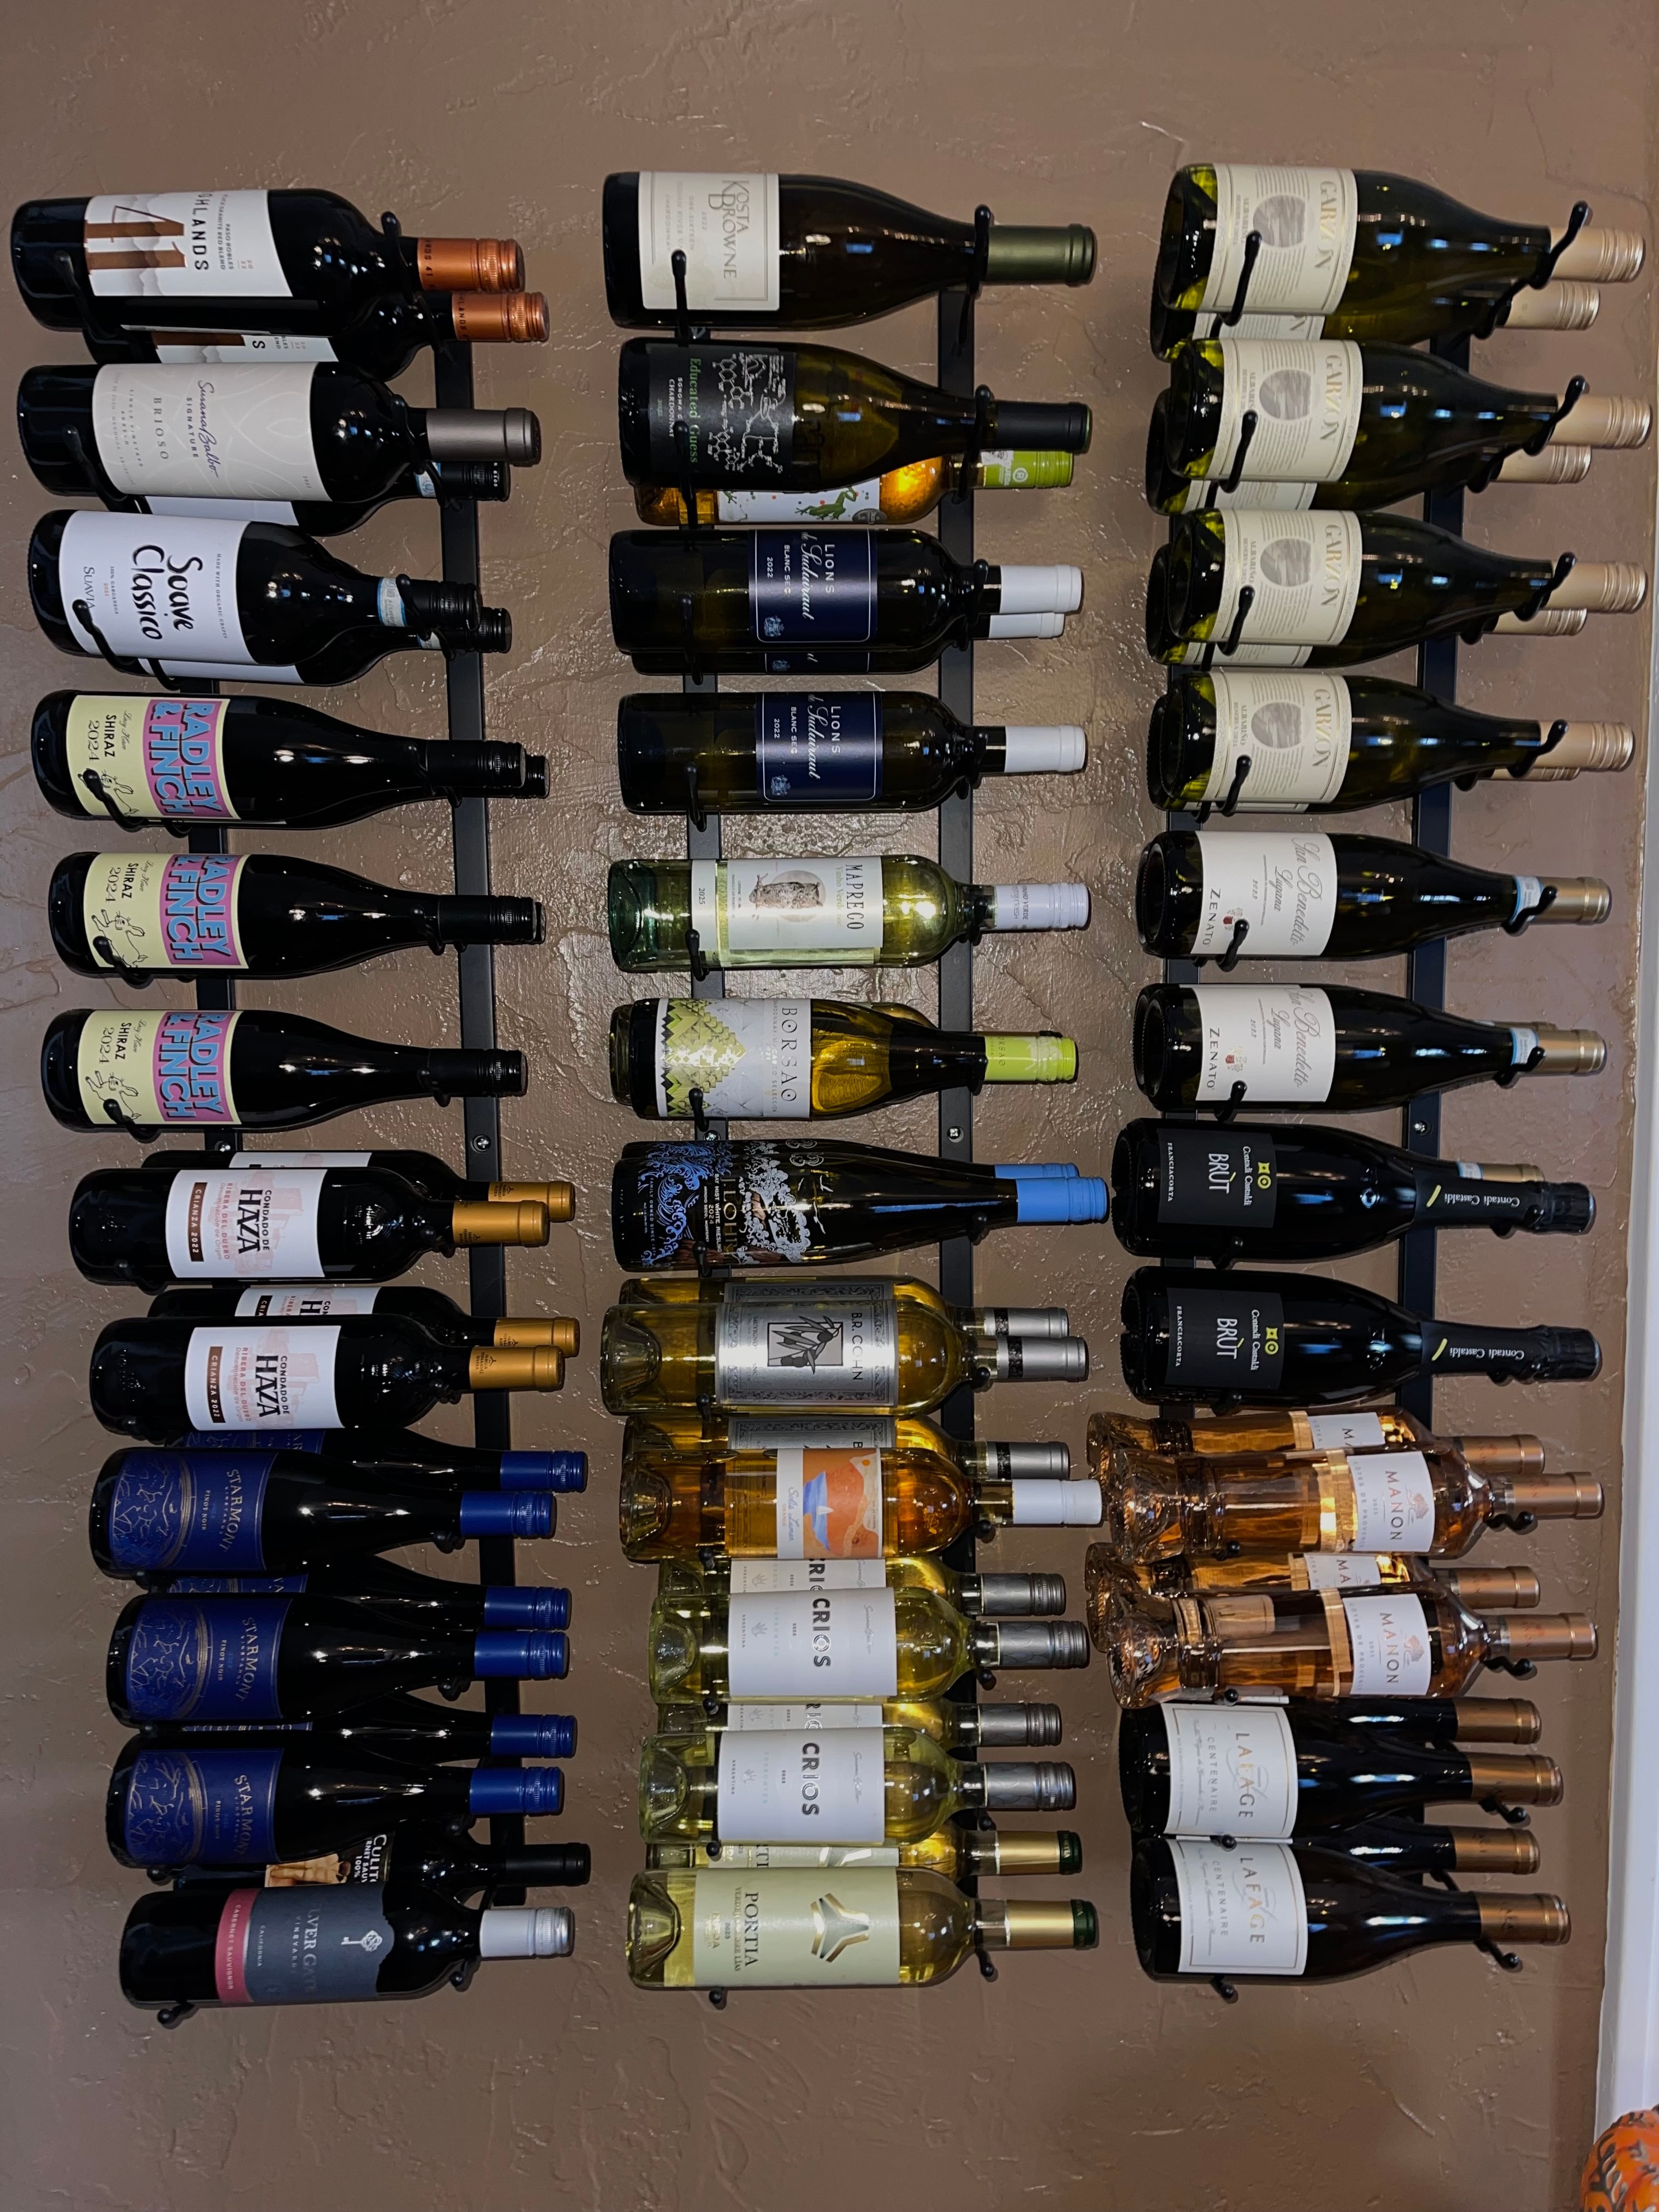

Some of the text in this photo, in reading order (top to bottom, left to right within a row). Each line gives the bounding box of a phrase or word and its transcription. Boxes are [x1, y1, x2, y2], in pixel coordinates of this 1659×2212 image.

[708, 194, 737, 280] BROWNE
[722, 180, 749, 233] KOSTA
[226, 242, 234, 270] ROBLES
[120, 410, 130, 446] AGRELO
[153, 397, 169, 461] BRIOSO
[186, 397, 199, 459] SIGNATURE
[689, 358, 701, 463] Educated Guess
[130, 425, 143, 469] VINEYARD
[84, 566, 96, 610] SUAVIA
[111, 581, 119, 615] GARGANEGA
[131, 544, 166, 641] Classico
[166, 554, 203, 632] Soave
[783, 574, 791, 594] SEC
[801, 531, 823, 621] de Suduiraut
[824, 544, 835, 594] LIONS
[218, 618, 228, 640] GRAPES
[87, 719, 100, 762] 2024
[104, 714, 118, 757] SHIRAZ
[181, 702, 223, 812] RADLEY
[808, 694, 828, 780] de Suduiraut
[831, 706, 841, 753] LIONS
[149, 724, 195, 814] FINCH
[105, 866, 122, 904] 2024
[121, 862, 139, 899] SHIRAZ
[196, 855, 233, 959] RADLEY
[698, 887, 706, 906] 2025
[835, 866, 844, 888] Vinho
[1269, 866, 1293, 912] Lugana
[1290, 865, 1323, 946] Benedetto
[166, 869, 203, 960] FINCH
[1202, 888, 1221, 946] ZENATO
[99, 1026, 115, 1065] 2024
[115, 1022, 132, 1060] SHIRAZ
[781, 1007, 798, 1103] BORSAO
[1206, 1027, 1220, 1088] ZENATO
[1266, 1007, 1290, 1049] Lugana
[1293, 1006, 1321, 1088] Benedetto
[158, 1029, 196, 1119] FINCH
[189, 1013, 227, 1115] RADLEY
[222, 1182, 234, 1209] RIBERA
[1243, 1146, 1253, 1206] Contadi Castaldi
[1442, 1193, 1521, 1209] Contadi Castaldi
[191, 1188, 202, 1254] CRIANZA 2022
[214, 1238, 223, 1260] Origen
[215, 1229, 222, 1237] de
[221, 1232, 231, 1260] DUERO
[237, 1188, 263, 1255] HAZA
[262, 1190, 272, 1251] CONDADO DE
[715, 1226, 723, 1253] RIESLING
[240, 1347, 249, 1377] RIBERA
[851, 1312, 863, 1380] B.R. COHN
[1175, 1305, 1183, 1367] FRANCIACORTA
[1250, 1309, 1261, 1371] Contadi Castaldi
[1449, 1347, 1525, 1361] Contadi Castaldi
[210, 1355, 221, 1418] CRIANZA 2022
[241, 1400, 251, 1422] DUERO
[255, 1354, 281, 1418] HAZA
[280, 1355, 290, 1415] CONDADO DE
[202, 1490, 211, 1511] PINOT
[218, 1468, 243, 1552] STARMONT
[1360, 1493, 1367, 1504] DE
[1384, 1469, 1404, 1541] MANON
[218, 1639, 228, 1661] PINOT
[234, 1617, 259, 1702] STARMONT
[812, 1598, 831, 1668] CRIOS
[1357, 1634, 1363, 1646] DE
[1380, 1612, 1400, 1684] MANON
[801, 1742, 821, 1816] CRIOS
[1207, 1737, 1218, 1812] CENTENAIRE
[1235, 1733, 1255, 1819] LAFAGE
[233, 1774, 254, 1856] STARMONT
[354, 1855, 363, 1878] 100%
[744, 1891, 760, 1967] PORTIA
[1212, 1861, 1229, 1936] CENTENAIRE
[1240, 1857, 1266, 1944] LAFAGE
[226, 1904, 241, 1990] CABERNET SAUVIGNON
[257, 1925, 266, 1967] CALIFORNIA
